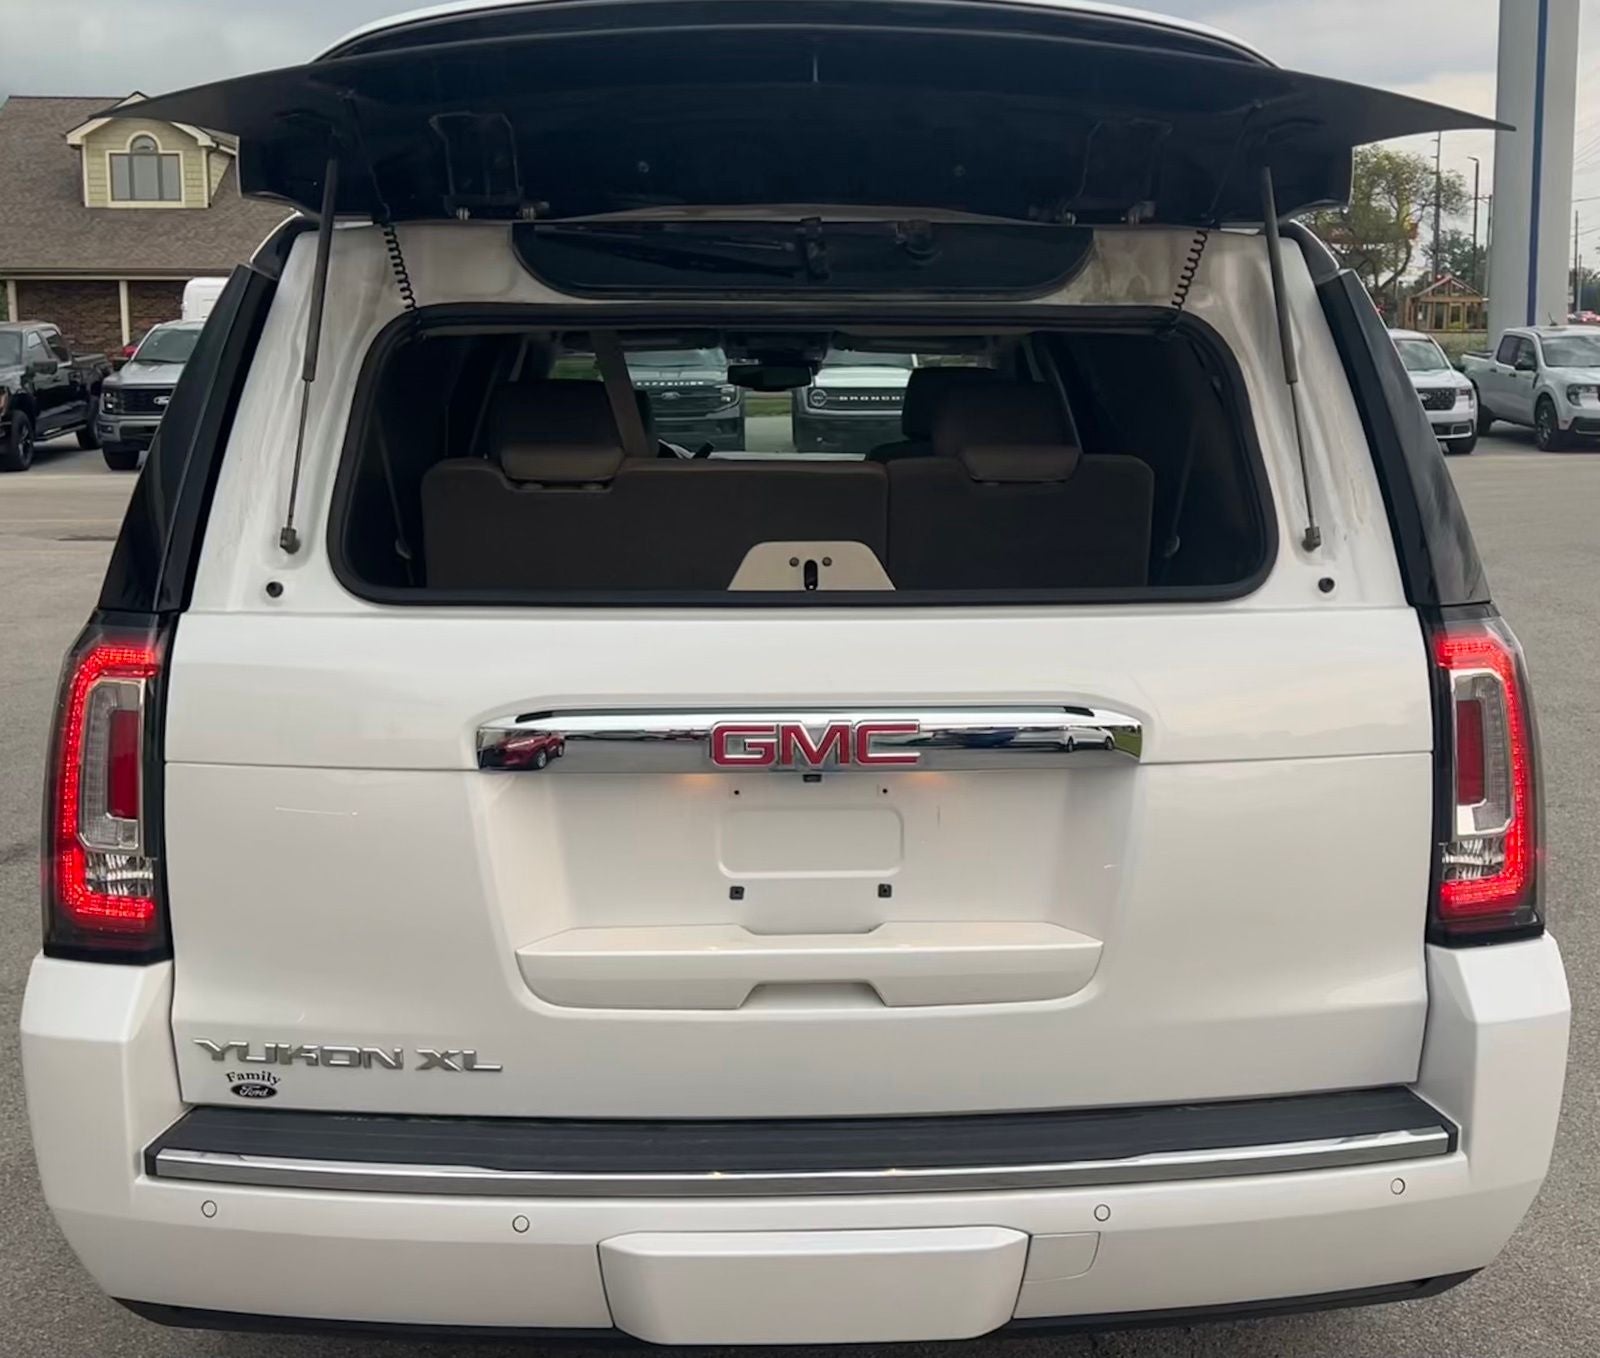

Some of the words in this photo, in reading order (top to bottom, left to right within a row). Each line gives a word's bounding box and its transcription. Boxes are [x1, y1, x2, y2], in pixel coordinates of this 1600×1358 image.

[710, 719, 921, 768] GMC
[193, 1039, 404, 1070] YUKON
[415, 1048, 503, 1073] XL
[226, 1070, 281, 1086] Family
[239, 1085, 270, 1097] Ford
